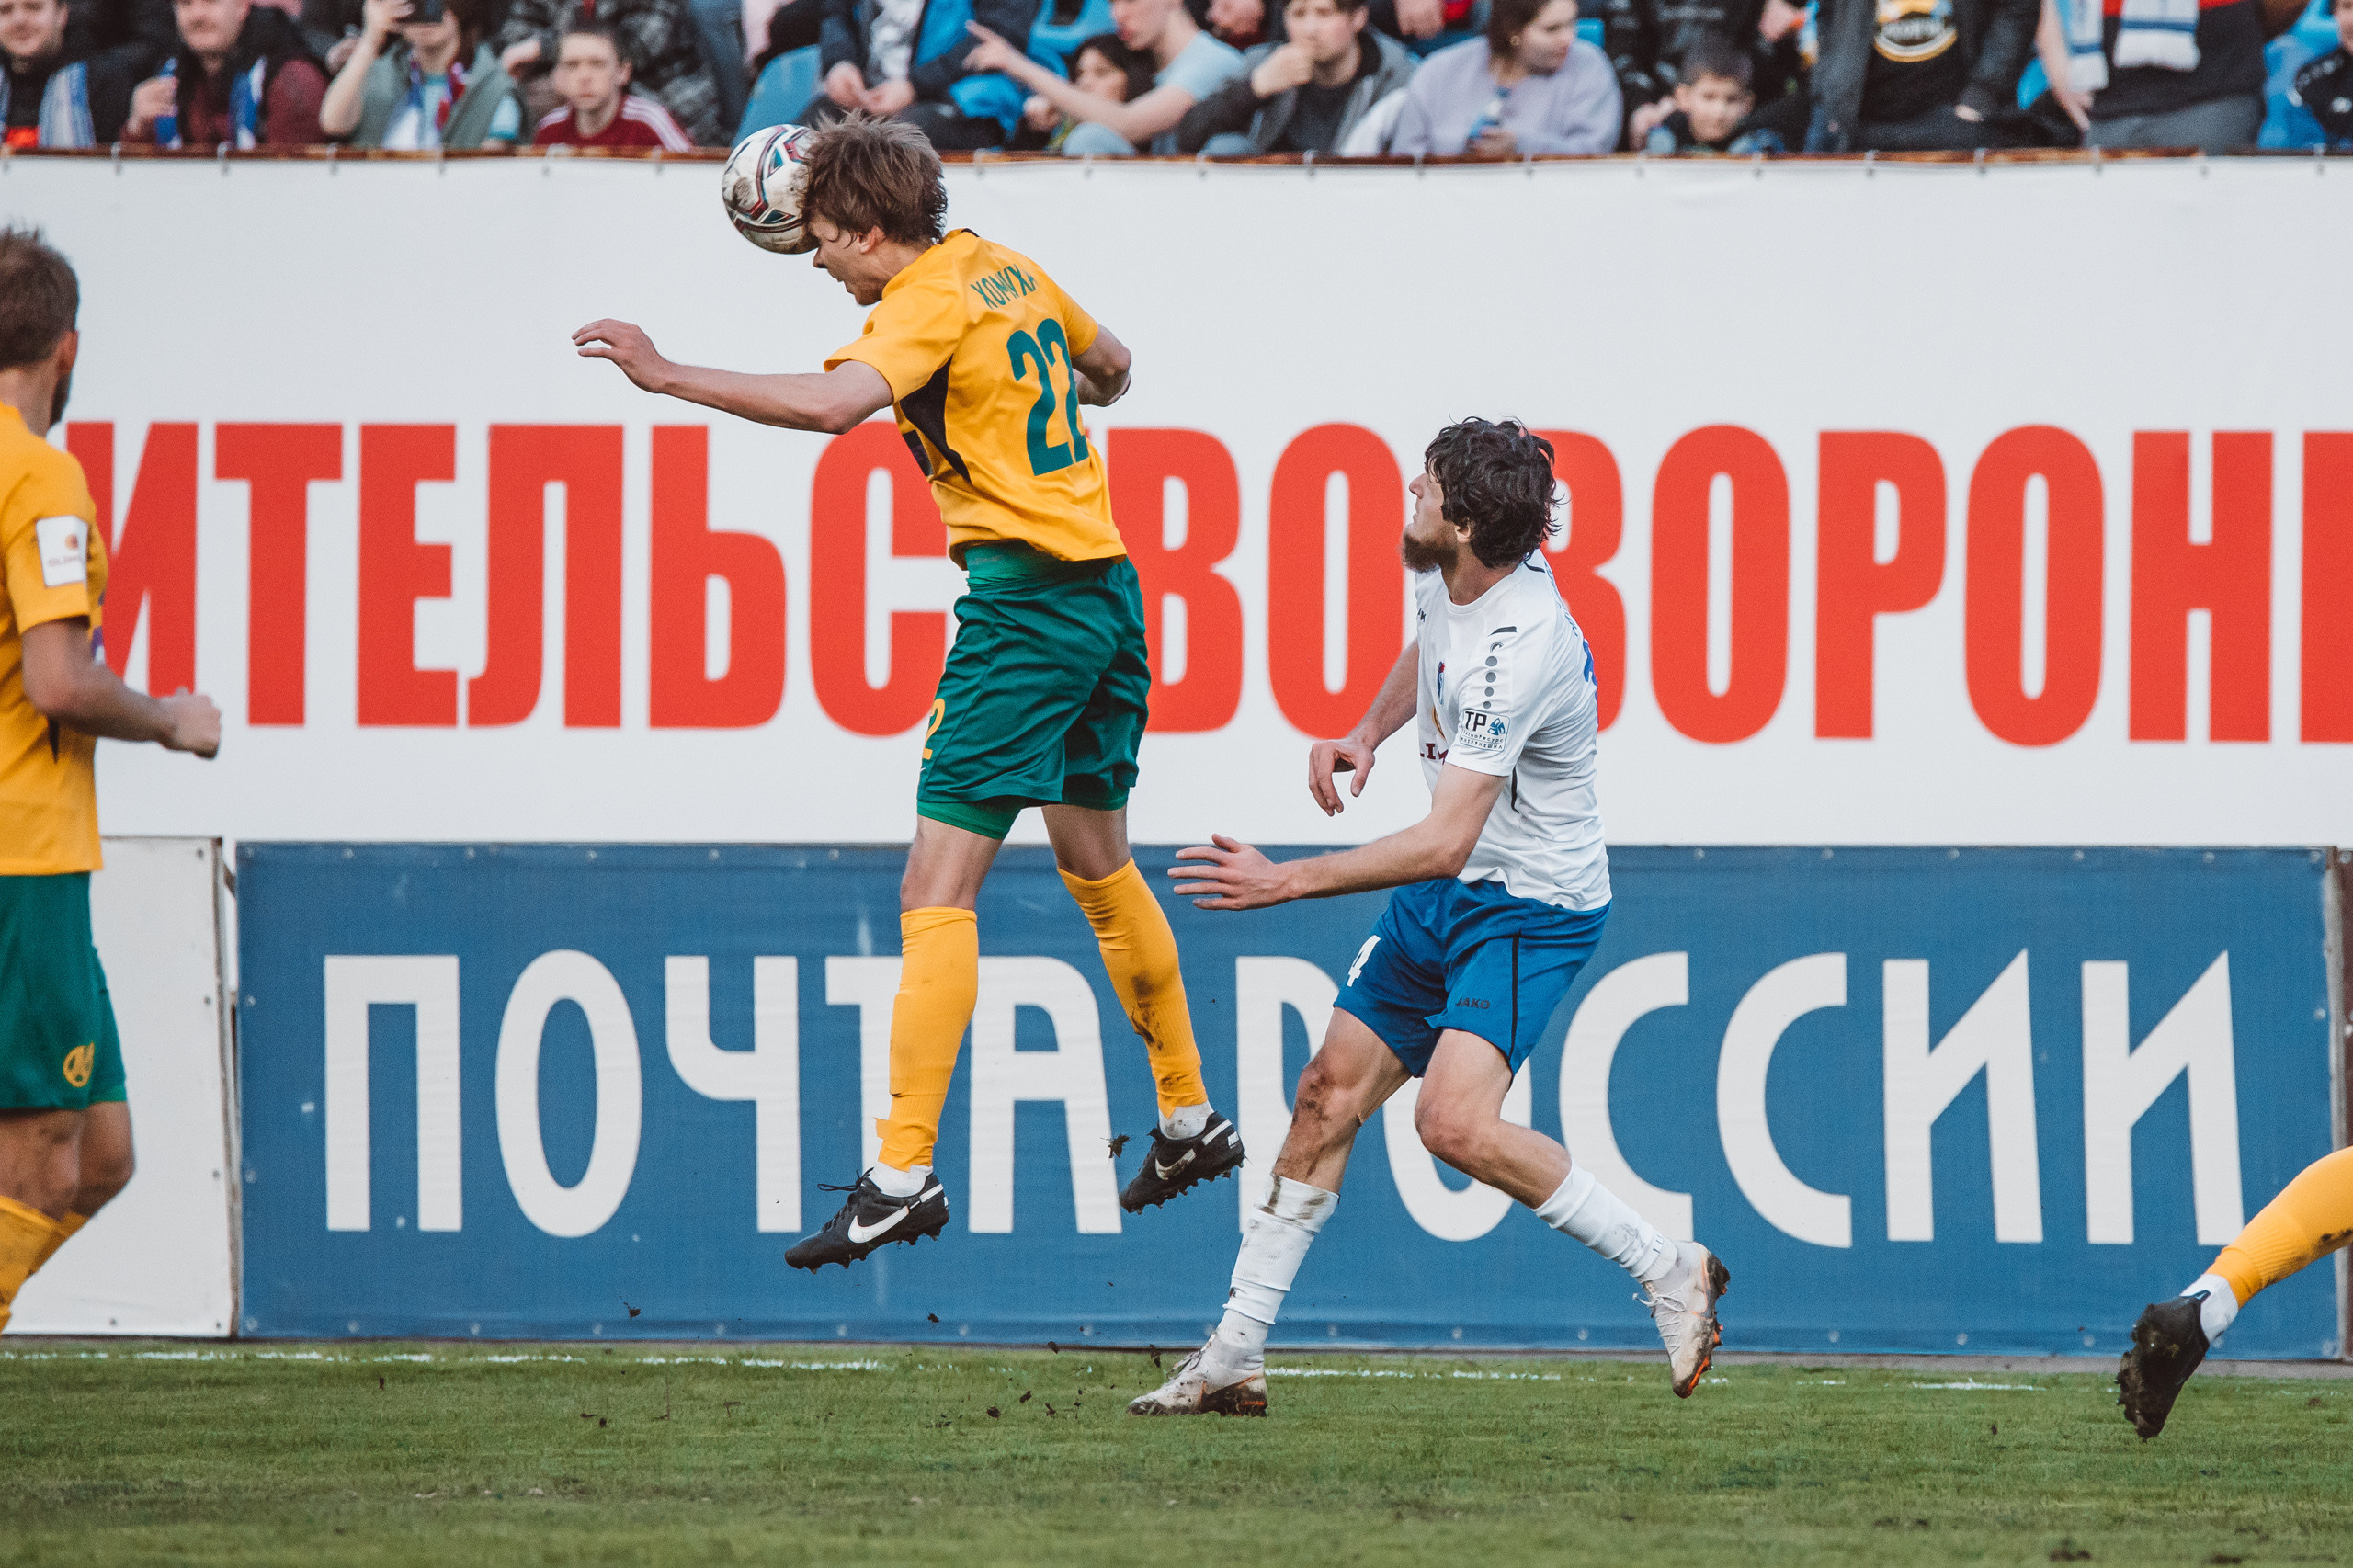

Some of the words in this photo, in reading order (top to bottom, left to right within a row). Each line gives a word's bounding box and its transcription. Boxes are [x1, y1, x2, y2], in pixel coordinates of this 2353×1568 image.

[1006, 317, 1090, 477] 22
[66, 420, 1405, 741] ИТЕЛЬСВО
[1454, 996, 1491, 1010] JAKO
